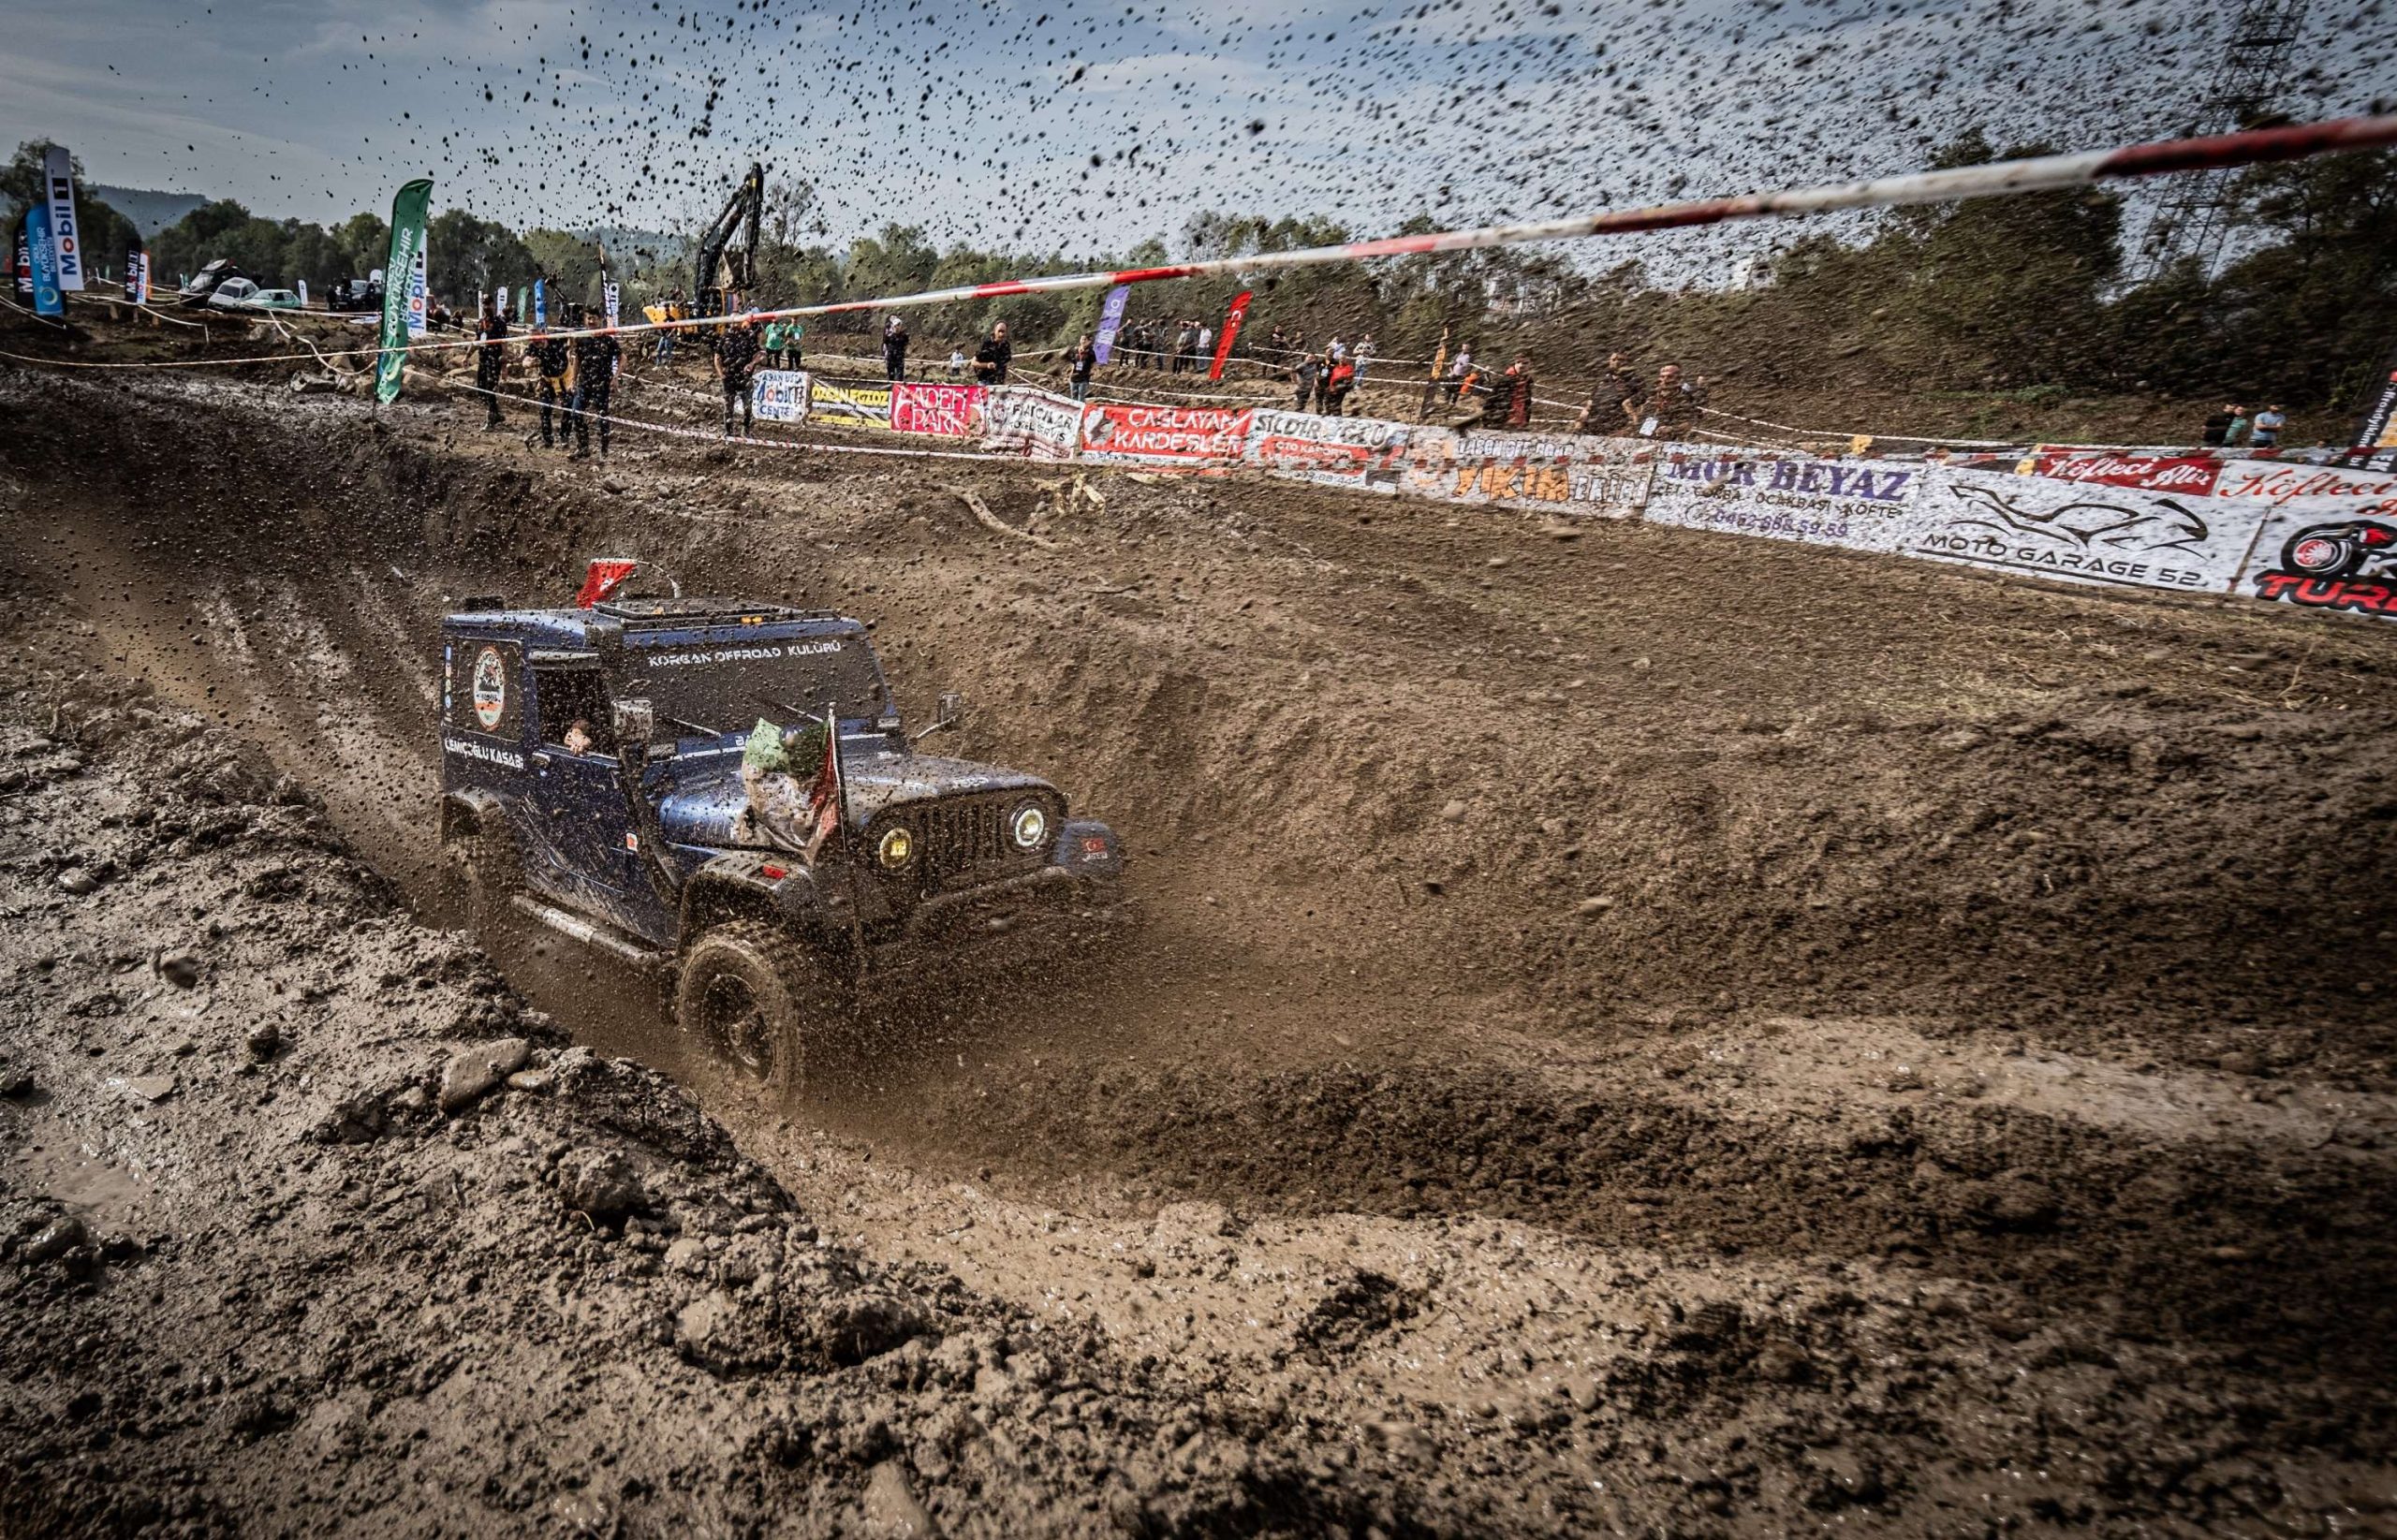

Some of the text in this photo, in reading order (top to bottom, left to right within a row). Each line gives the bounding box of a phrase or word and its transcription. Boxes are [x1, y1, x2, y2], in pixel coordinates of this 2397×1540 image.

[55, 206, 77, 275] Mobil
[759, 404, 794, 417] CENTE
[1768, 461, 1911, 501] BEYAZ
[2046, 457, 2159, 483] Köfteci
[2219, 469, 2397, 506] Köfteci
[1922, 534, 2201, 587] MOTO GARAGE 52
[648, 652, 712, 667] KORGAN
[714, 647, 782, 662] OFFROAD
